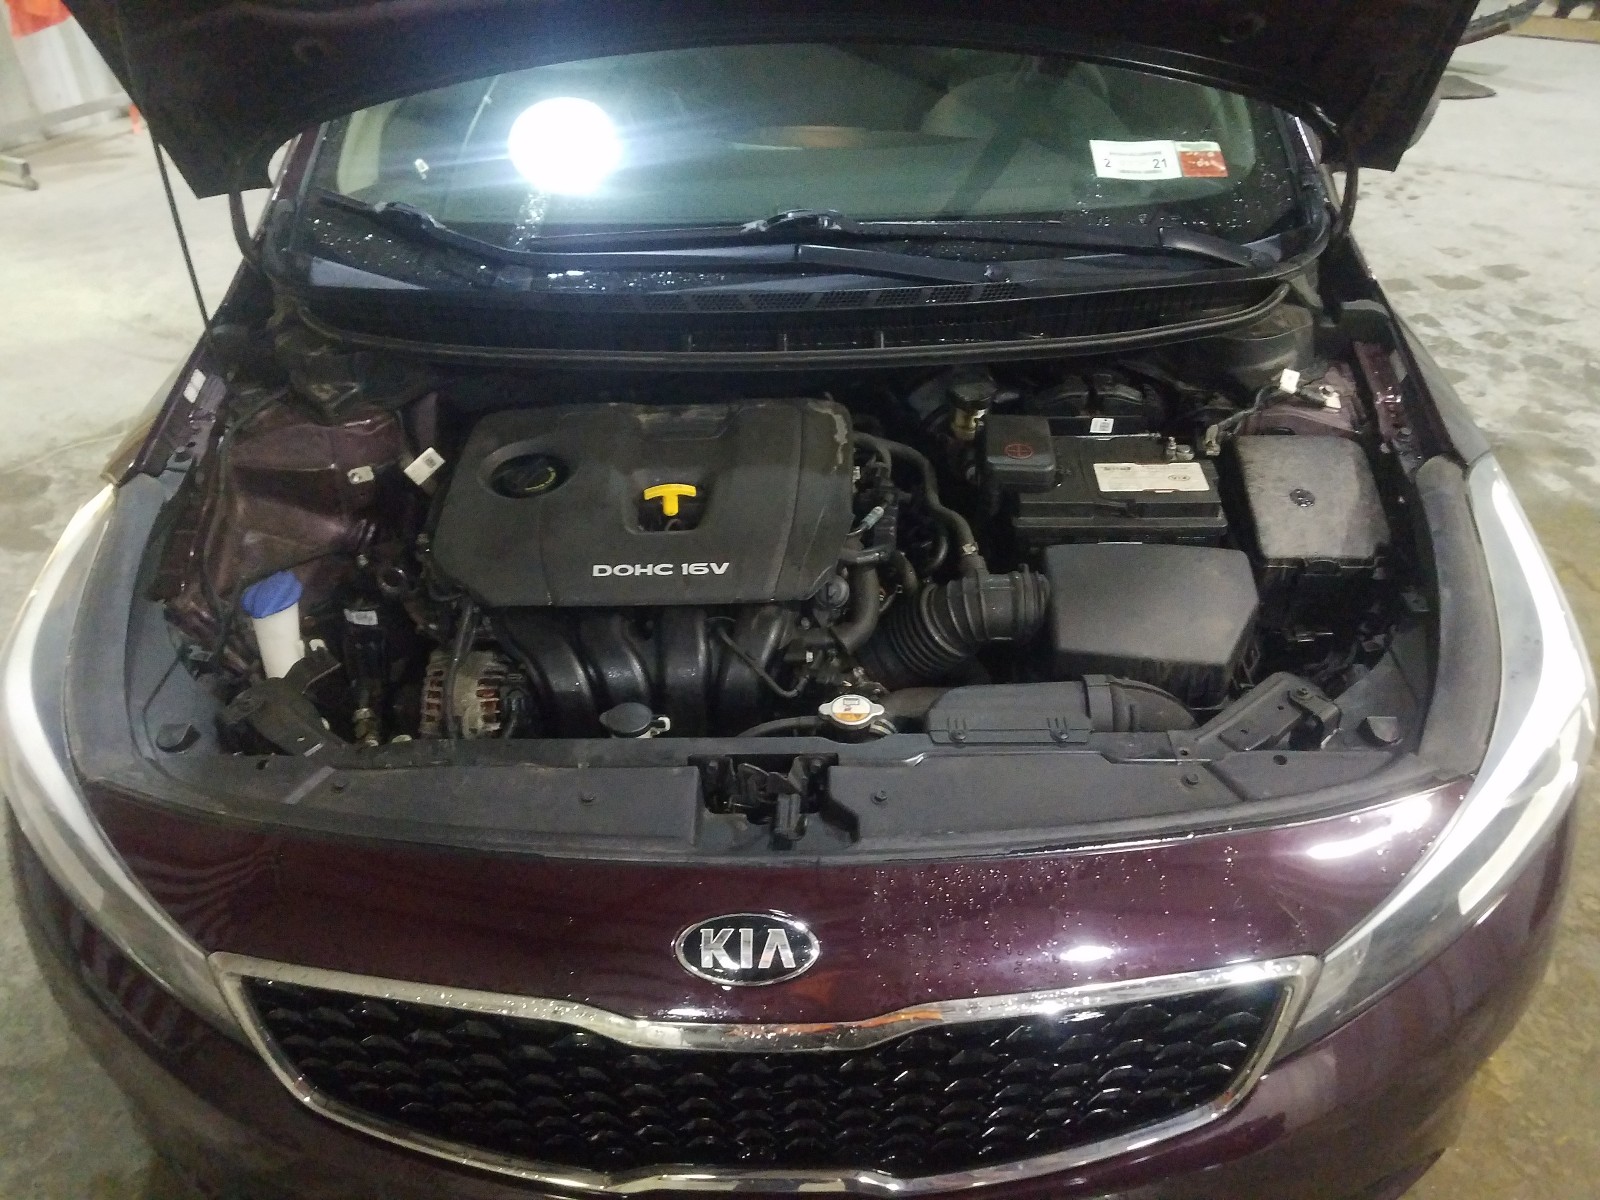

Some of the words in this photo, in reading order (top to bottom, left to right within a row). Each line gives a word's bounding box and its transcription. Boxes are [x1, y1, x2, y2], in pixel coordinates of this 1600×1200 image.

[1103, 158, 1112, 168] 2
[1152, 158, 1168, 169] 21
[592, 563, 674, 577] DOHC
[681, 562, 730, 575] 16V
[699, 928, 796, 969] KIA
